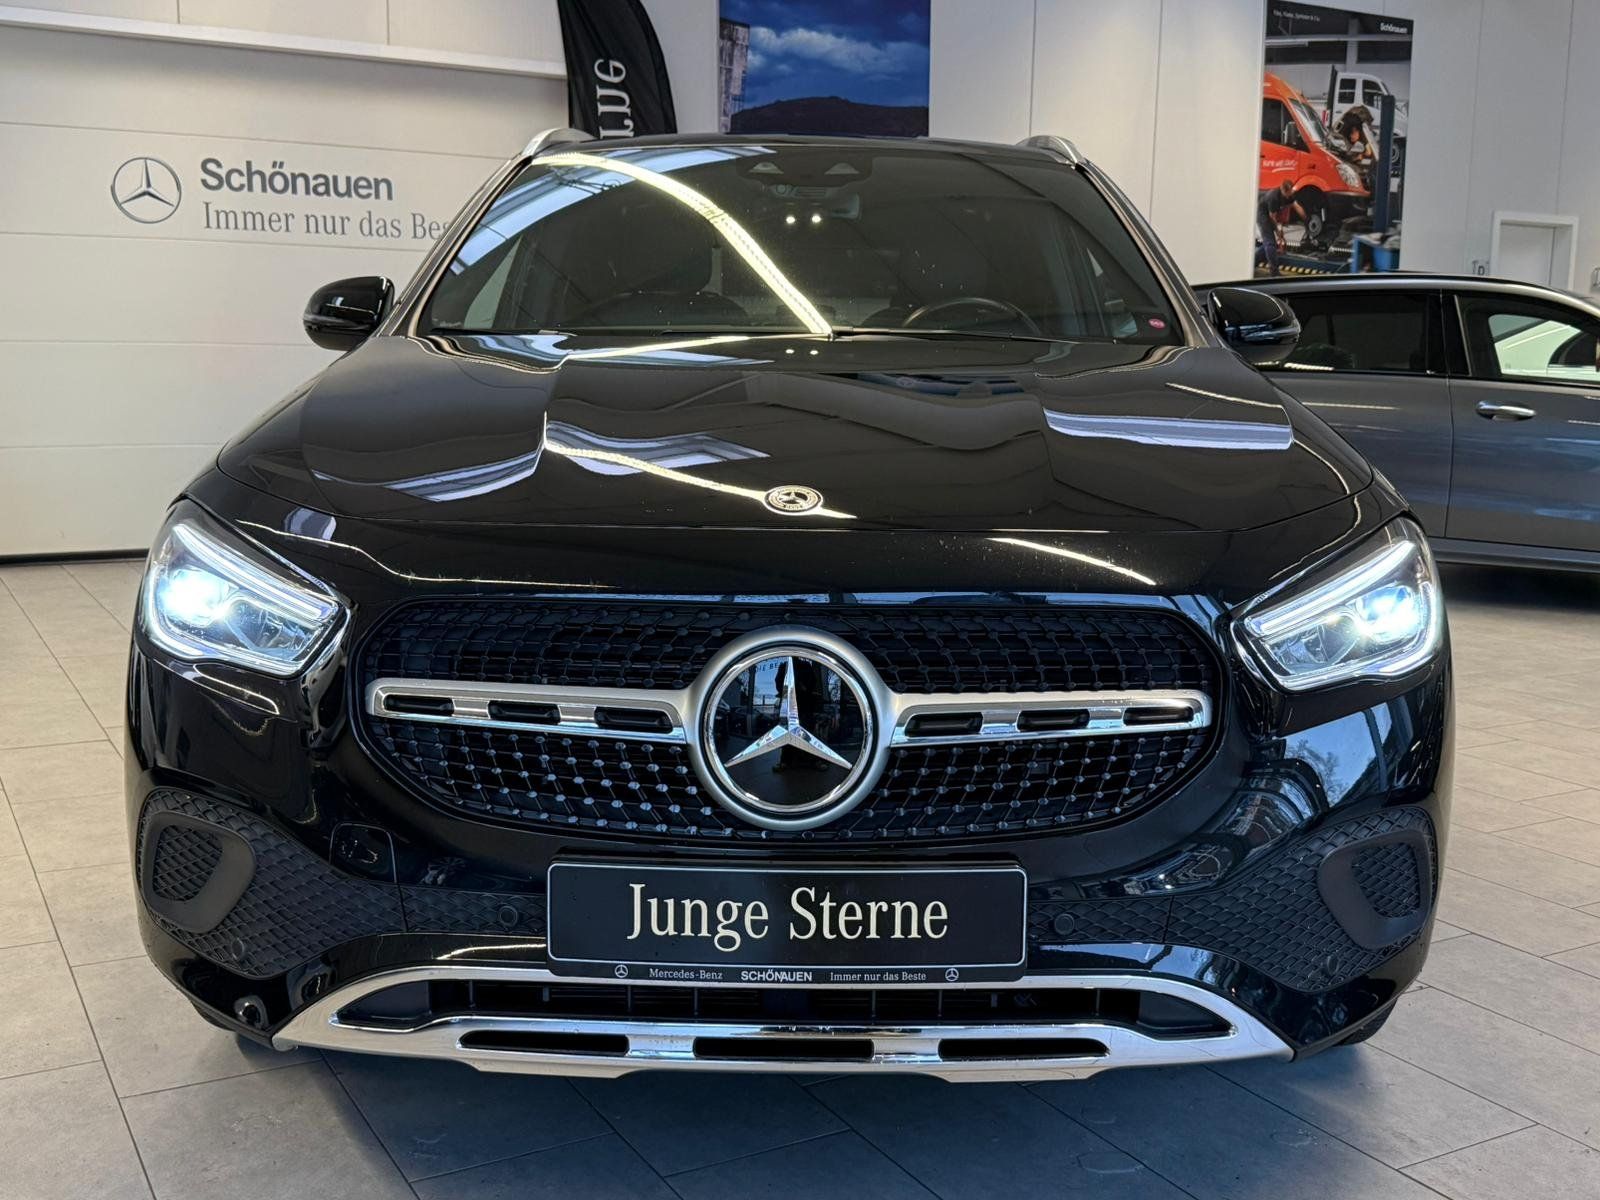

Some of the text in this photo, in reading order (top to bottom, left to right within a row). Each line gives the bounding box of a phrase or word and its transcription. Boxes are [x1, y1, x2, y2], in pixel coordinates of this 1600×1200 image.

[200, 157, 393, 201] Schönauen
[202, 201, 295, 234] Immer
[304, 213, 351, 236] nur
[359, 210, 402, 239] das
[626, 883, 948, 952] Junge Sterne
[649, 968, 723, 980] Mercedes-Benz
[830, 971, 862, 981] Immer
[863, 973, 881, 981] nur
[882, 971, 899, 981] das
[901, 971, 927, 981] Beste
